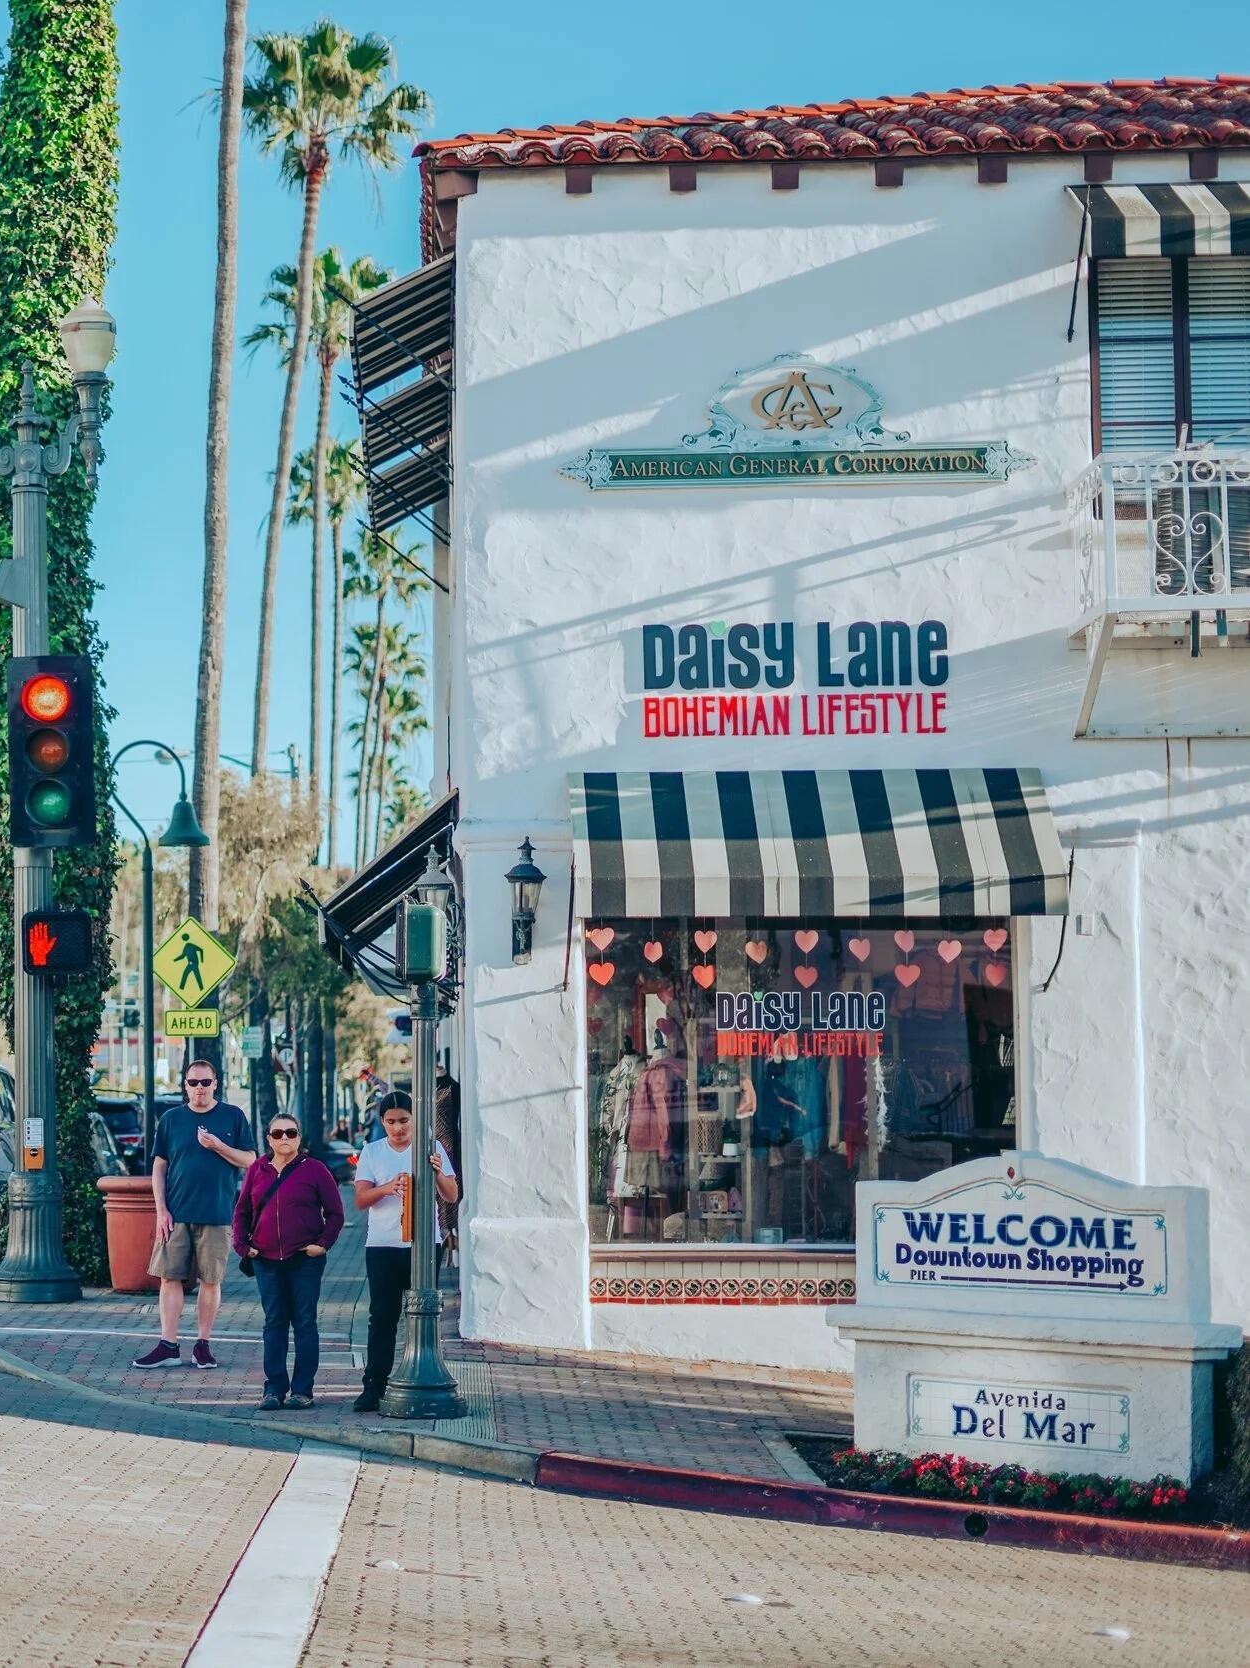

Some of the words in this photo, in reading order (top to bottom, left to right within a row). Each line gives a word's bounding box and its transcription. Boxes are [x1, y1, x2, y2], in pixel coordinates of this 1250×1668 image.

[611, 456, 722, 478] AMERICAN
[728, 454, 827, 476] GENERAL
[834, 452, 986, 474] CORPORATION
[642, 620, 795, 690] Daisy
[817, 620, 949, 688] Lane
[643, 695, 791, 738] BOHEMIAN
[801, 692, 947, 735] LIFESTYLE
[171, 1016, 212, 1030] AHEAD
[716, 991, 801, 1031] Daisy
[811, 991, 886, 1031] Lane
[803, 1032, 884, 1057] LIFESTYLE
[901, 1211, 1137, 1250] WELCOME
[896, 1243, 1022, 1271] Downtown
[1027, 1249, 1144, 1287] Shopping
[910, 1269, 936, 1281] PIER
[975, 1389, 1066, 1411] Avenida
[953, 1403, 1006, 1439] Del
[1023, 1411, 1096, 1445] Mar
